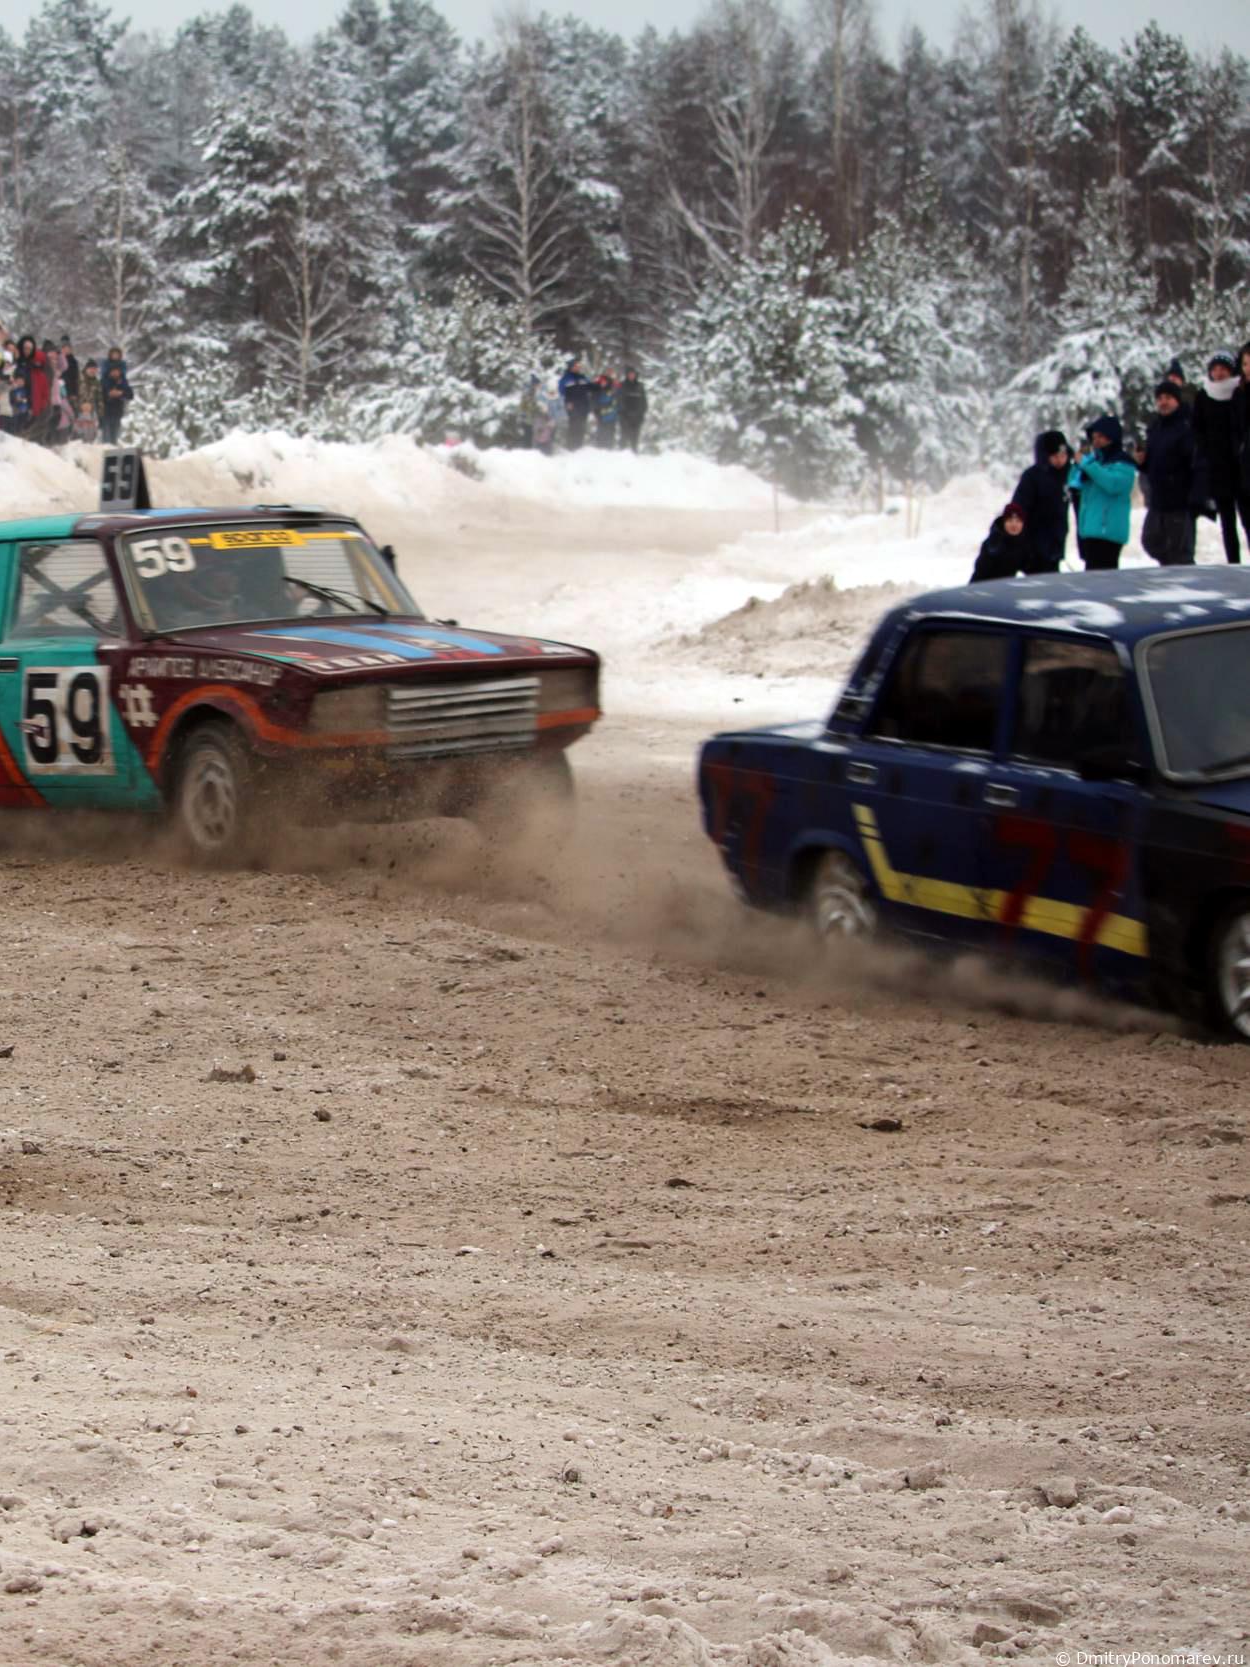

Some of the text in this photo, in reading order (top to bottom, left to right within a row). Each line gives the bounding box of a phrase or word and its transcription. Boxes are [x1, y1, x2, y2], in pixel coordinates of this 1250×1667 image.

[102, 455, 134, 501] 59
[130, 537, 196, 578] 59
[27, 672, 104, 764] 59
[993, 814, 1134, 965] 77
